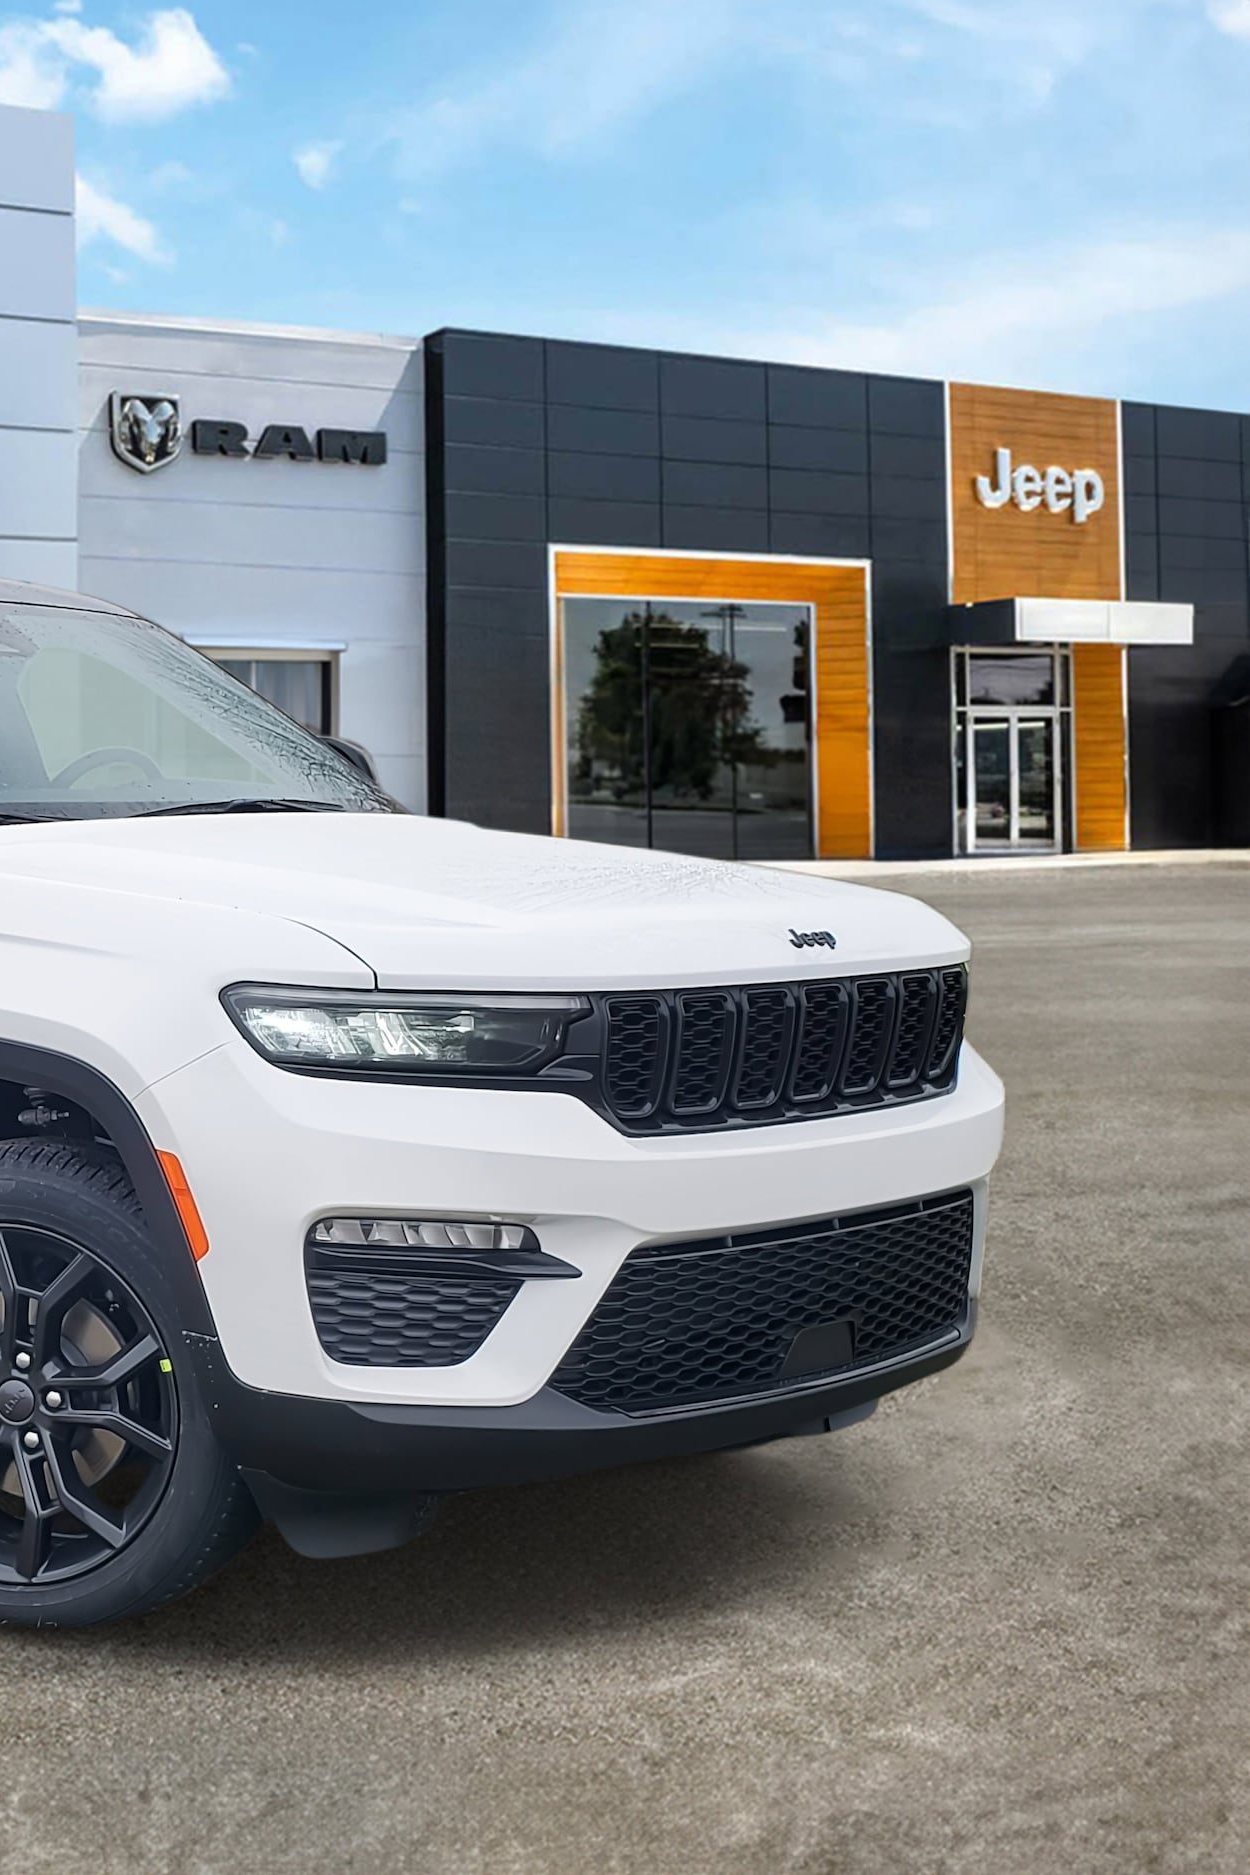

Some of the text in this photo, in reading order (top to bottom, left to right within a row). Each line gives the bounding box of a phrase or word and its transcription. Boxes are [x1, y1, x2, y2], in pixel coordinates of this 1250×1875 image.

[191, 419, 387, 466] RAM
[975, 447, 1104, 523] Jeep
[788, 928, 837, 950] Jeep
